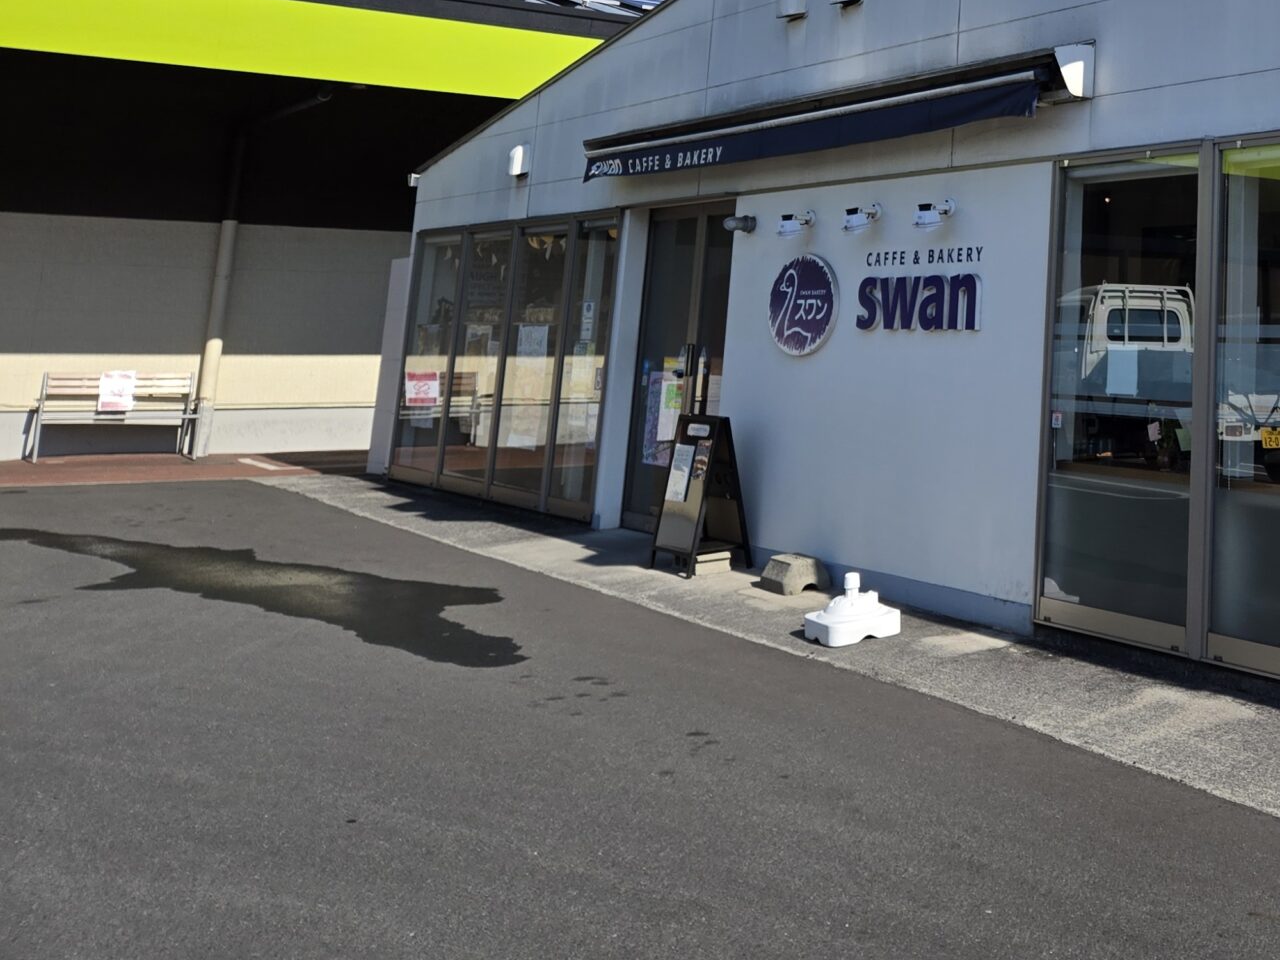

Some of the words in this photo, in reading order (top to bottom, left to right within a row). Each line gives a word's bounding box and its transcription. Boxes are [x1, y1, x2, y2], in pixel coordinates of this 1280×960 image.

[628, 155, 660, 173] CAFFE
[664, 154, 671, 169] &
[677, 146, 723, 168] BAKERY
[866, 251, 905, 266] CAFFE
[913, 250, 920, 265] &
[928, 246, 984, 264] BAKERY
[795, 299, 827, 320] スワン
[855, 273, 981, 330] swan
